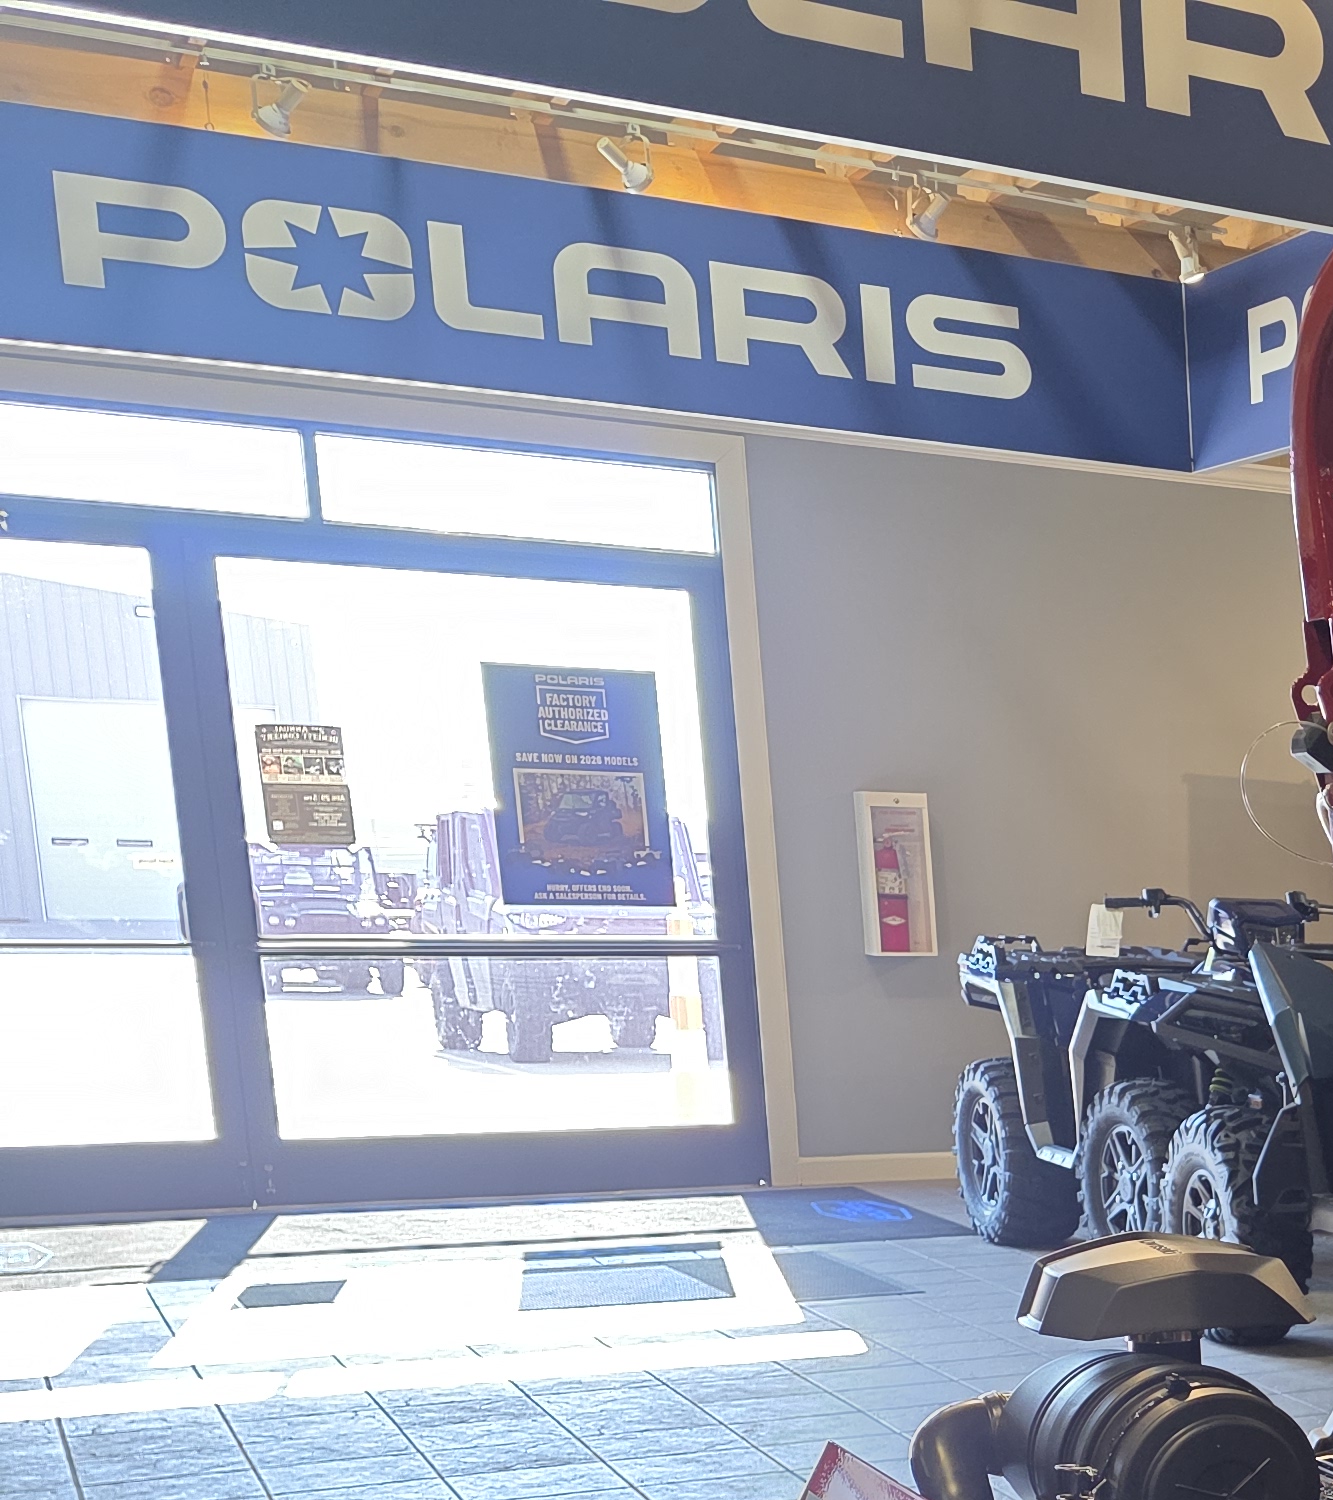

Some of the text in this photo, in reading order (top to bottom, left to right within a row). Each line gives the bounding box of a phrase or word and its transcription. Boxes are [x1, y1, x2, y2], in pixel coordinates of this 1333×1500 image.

[52, 170, 1033, 400] POLARIS
[534, 674, 605, 687] POLARIS
[545, 692, 597, 708] FACTORY
[537, 706, 609, 721] AUTHORIZED
[544, 719, 604, 733] CLEARANCE
[515, 752, 539, 763] SAVE
[541, 753, 563, 764] NOW
[565, 754, 578, 764] ON
[604, 756, 639, 767] MODELS
